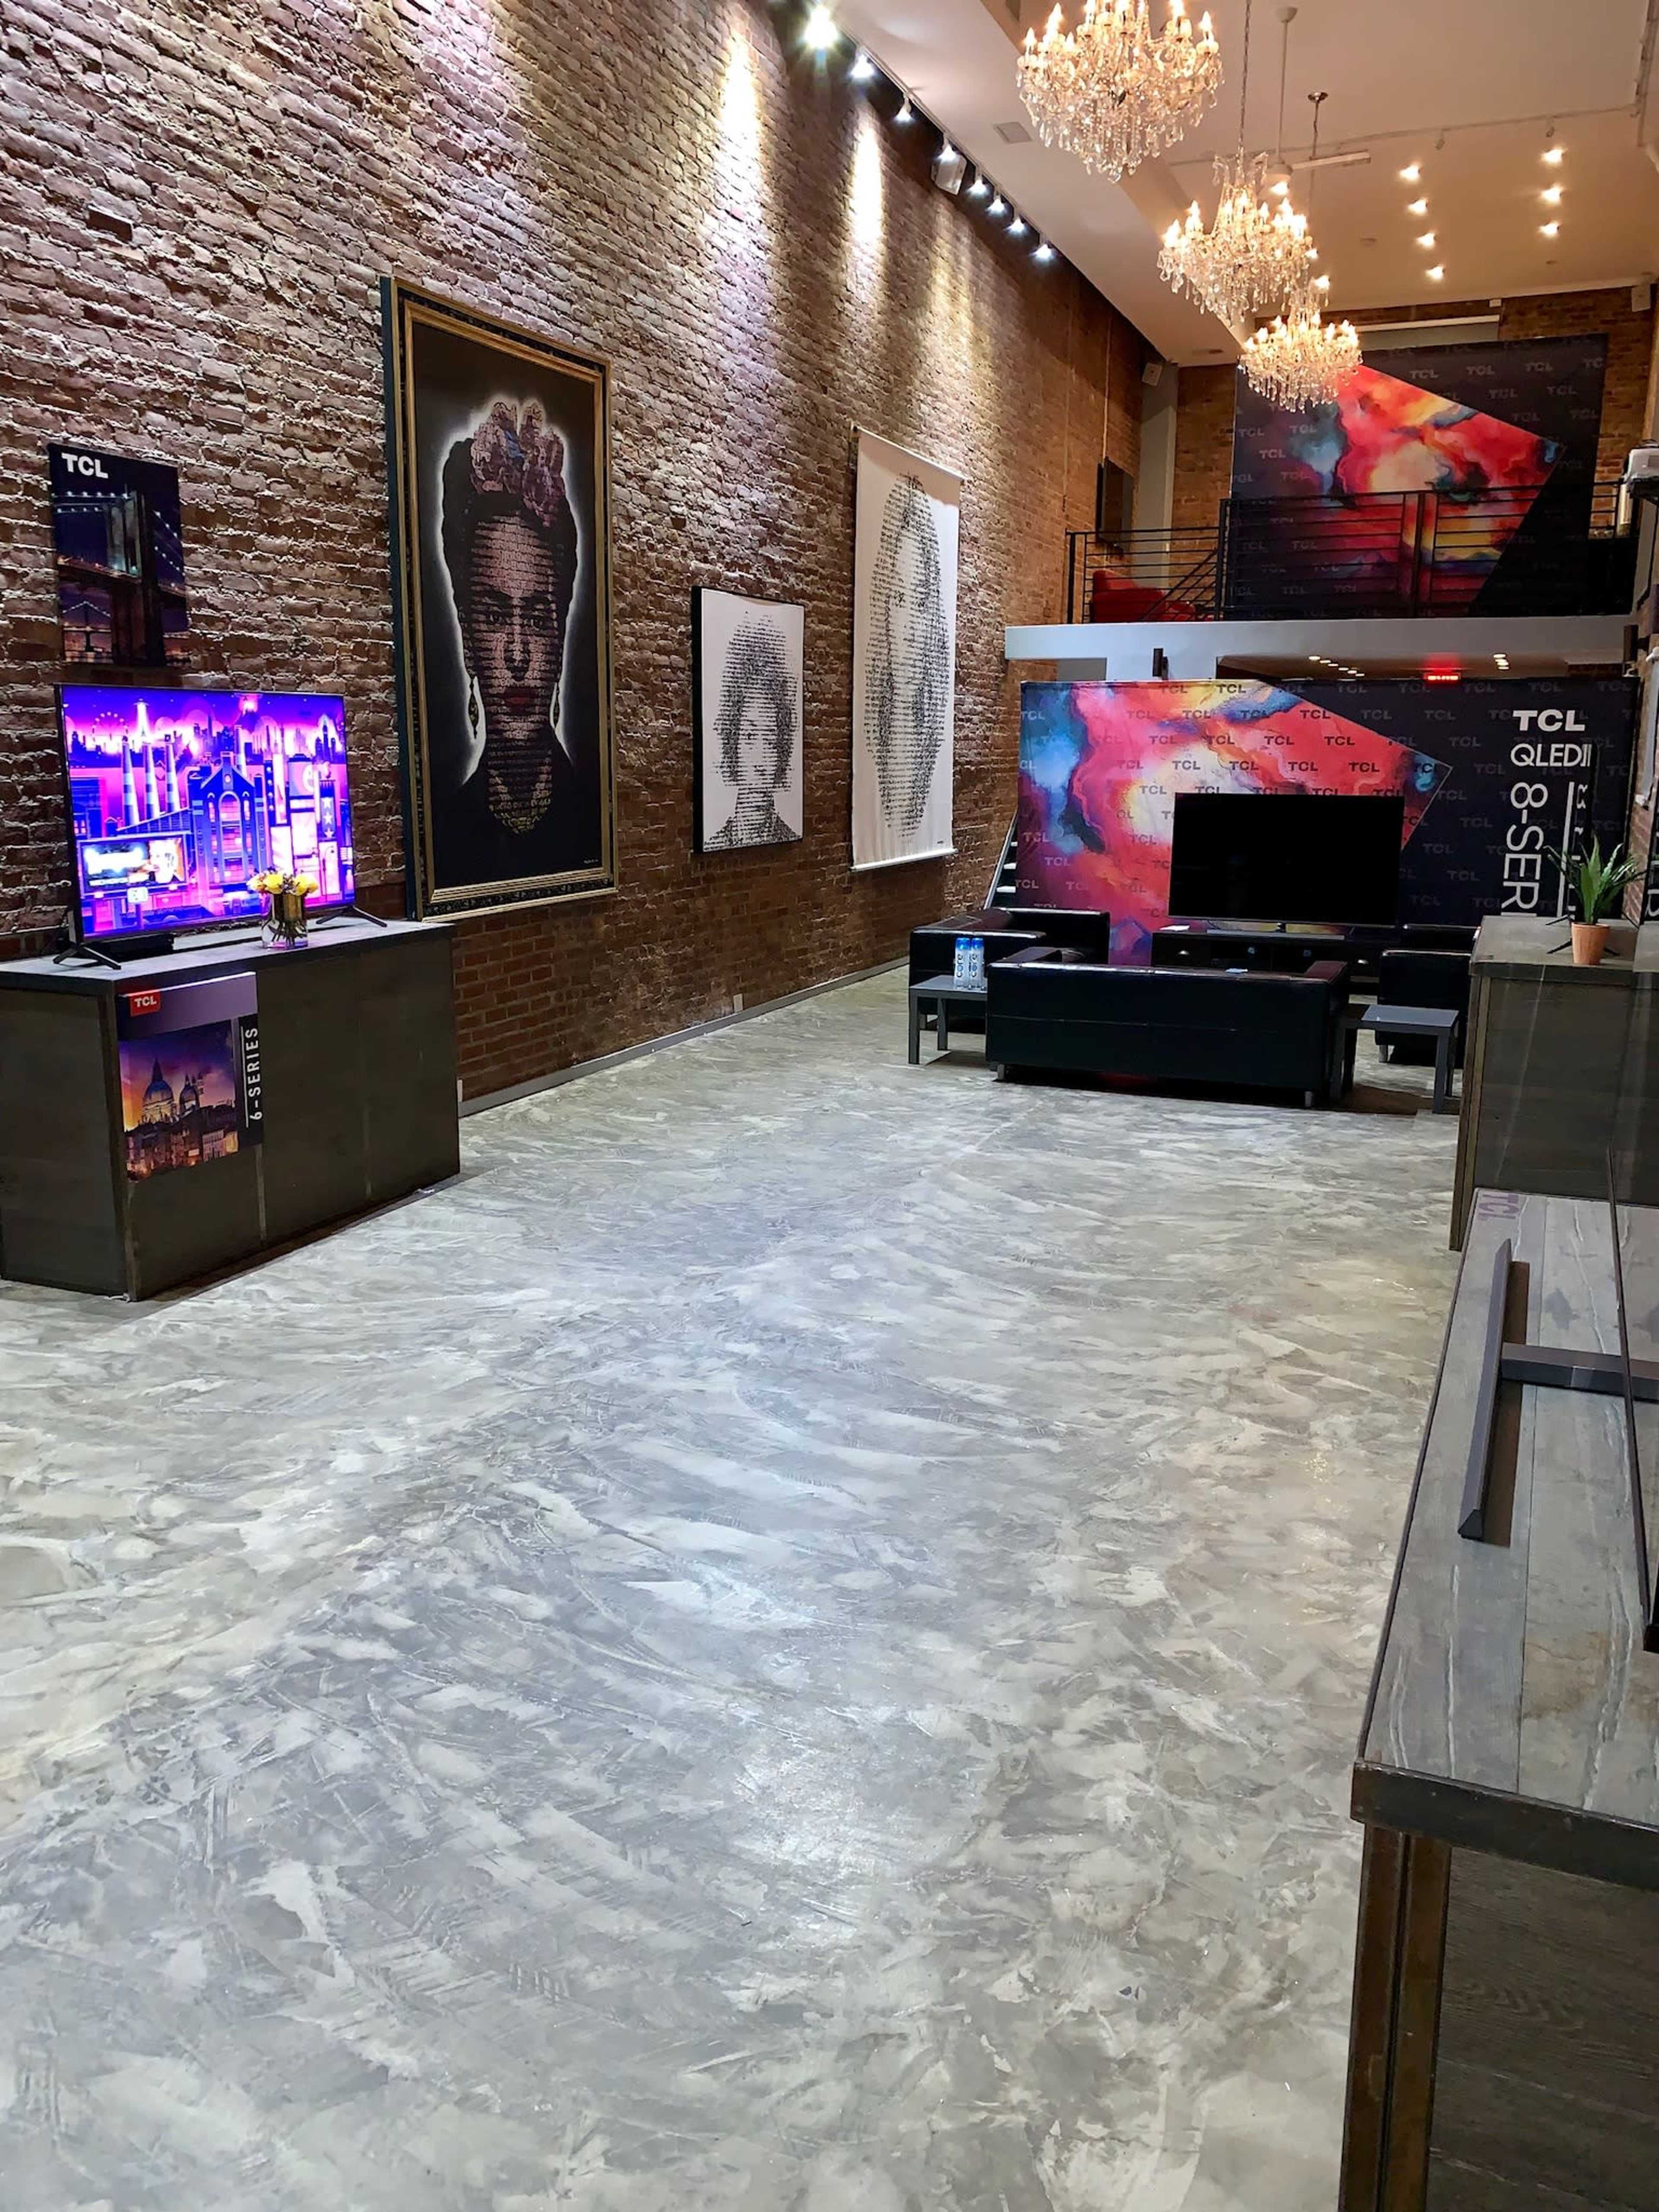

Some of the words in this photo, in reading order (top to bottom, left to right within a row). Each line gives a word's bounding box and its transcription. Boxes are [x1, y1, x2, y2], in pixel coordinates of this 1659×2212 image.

[1524, 363, 1553, 372] TCL
[1584, 358, 1603, 368] TC
[1409, 369, 1439, 379] TCL
[1466, 365, 1496, 376] TCL
[1487, 389, 1518, 398] TCL
[1547, 385, 1577, 395] TCL
[1238, 428, 1265, 437] TCL
[1289, 425, 1317, 433] TCL
[1259, 449, 1286, 458] TCL
[62, 453, 108, 478] TCL
[1234, 474, 1254, 483] CL
[1161, 685, 1188, 694] TCL
[1216, 684, 1246, 693] TCL
[1338, 684, 1368, 694] TCL
[1021, 710, 1045, 720] TCL
[1126, 710, 1156, 719] TCL
[1182, 710, 1211, 719] TCL
[1300, 710, 1331, 719] TCL
[1361, 709, 1392, 720] TCL
[1424, 710, 1456, 720] TCL
[1488, 710, 1516, 720] TC
[1513, 709, 1585, 731] TCL
[1149, 735, 1179, 744] TCL
[1207, 735, 1235, 745] TCL
[1264, 735, 1295, 745] TCL
[1324, 736, 1356, 746] TCL
[1448, 736, 1481, 747] TCL
[1020, 761, 1036, 769] CL
[1116, 760, 1144, 769] TCL
[1172, 761, 1201, 770] TCL
[1229, 761, 1260, 770] TCL
[1287, 761, 1319, 771] TCL
[1348, 762, 1380, 772] TCL
[1473, 764, 1506, 775] TCL
[1605, 765, 1627, 776] TC
[1139, 785, 1168, 795] TCL
[1459, 817, 1493, 828] TCL
[1022, 832, 1049, 842] TCL
[1422, 844, 1454, 853] TCL
[1486, 845, 1506, 855] TC
[1501, 782, 1548, 916] 8-SERI
[1045, 857, 1071, 866] TCL
[1153, 860, 1170, 869] TC
[1446, 870, 1480, 881] TCL
[1015, 879, 1039, 889] TCL
[134, 996, 157, 1007] TCL
[245, 1028, 262, 1120] 6-SERIES
[1478, 1193, 1519, 1221] TCL
